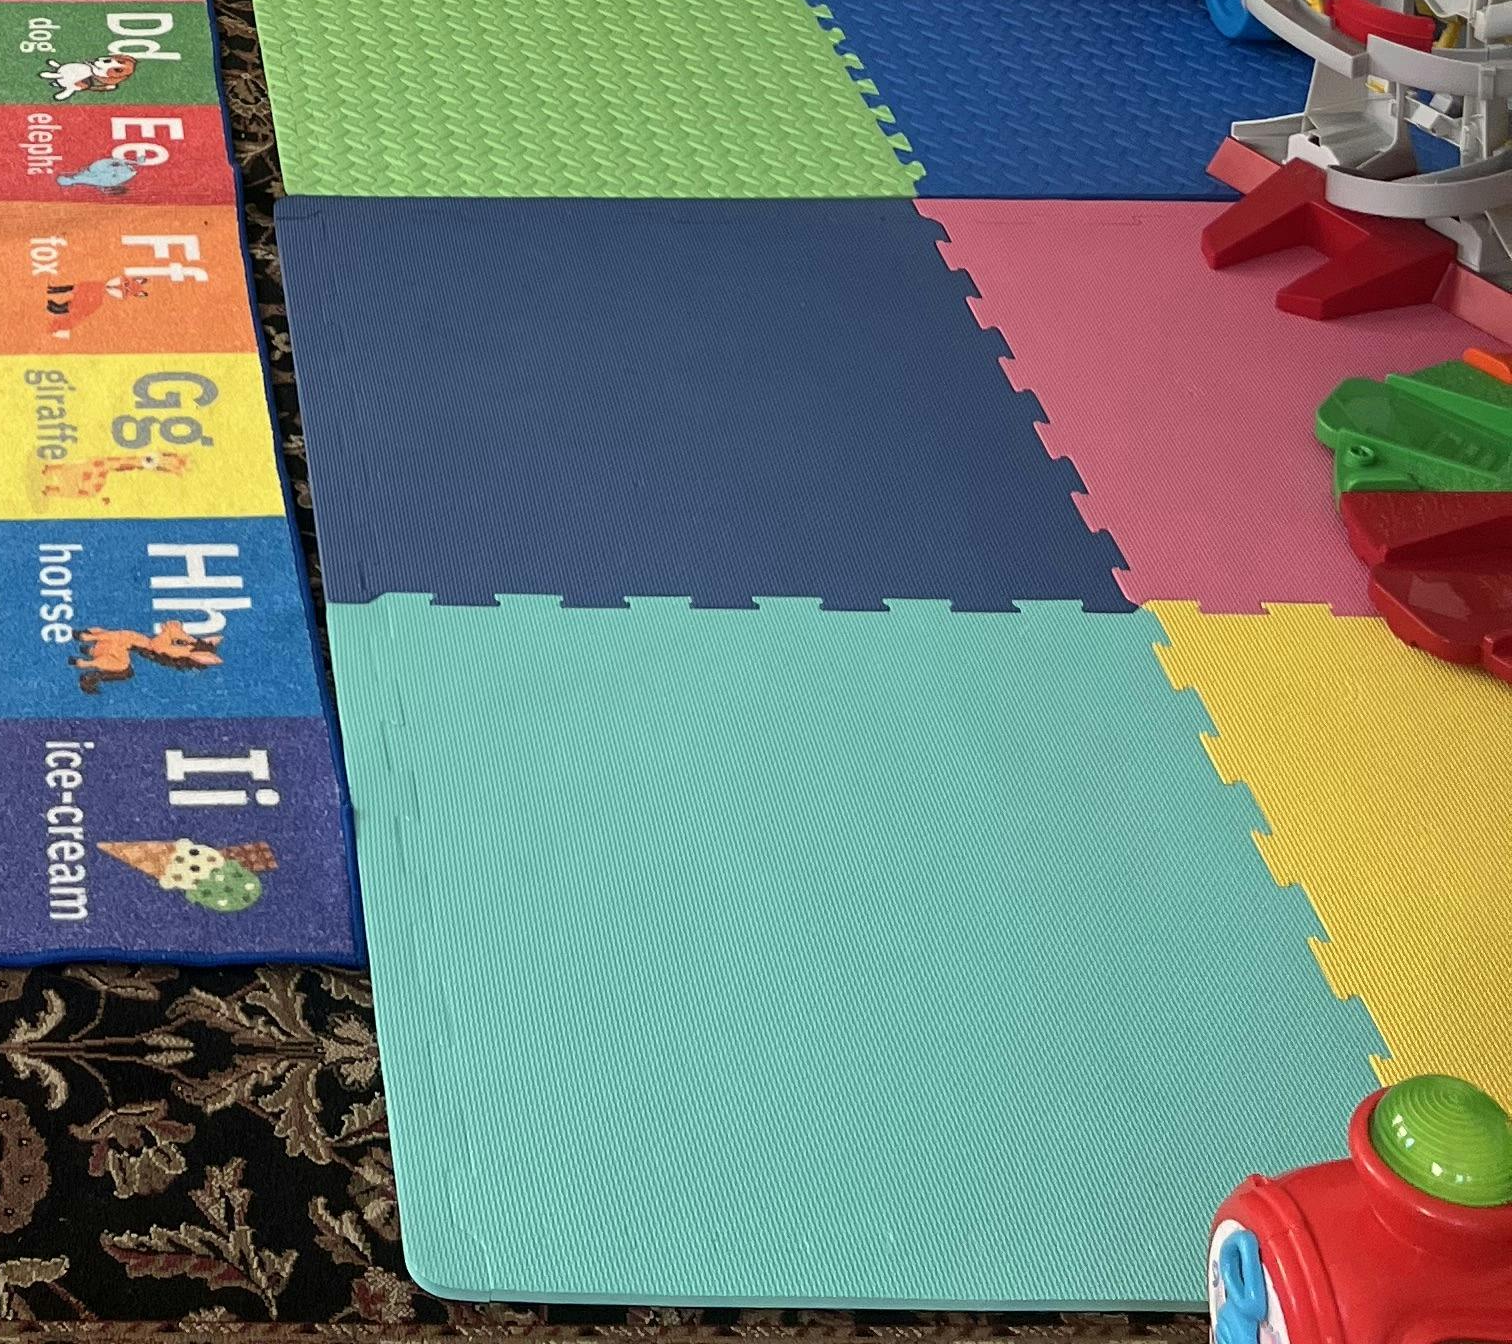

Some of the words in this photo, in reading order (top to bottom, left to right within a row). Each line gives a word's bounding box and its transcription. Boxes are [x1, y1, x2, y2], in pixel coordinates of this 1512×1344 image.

[19, 16, 62, 54] dog
[106, 12, 182, 60] Dd
[109, 116, 185, 168] Ee
[30, 235, 71, 276] fox
[121, 234, 208, 283] Ff
[23, 368, 78, 461] giraffe
[112, 371, 219, 449] Gg
[38, 542, 83, 643] horse
[146, 542, 251, 635] Hh
[165, 748, 280, 806] Ii
[44, 740, 95, 921] ice-cream
